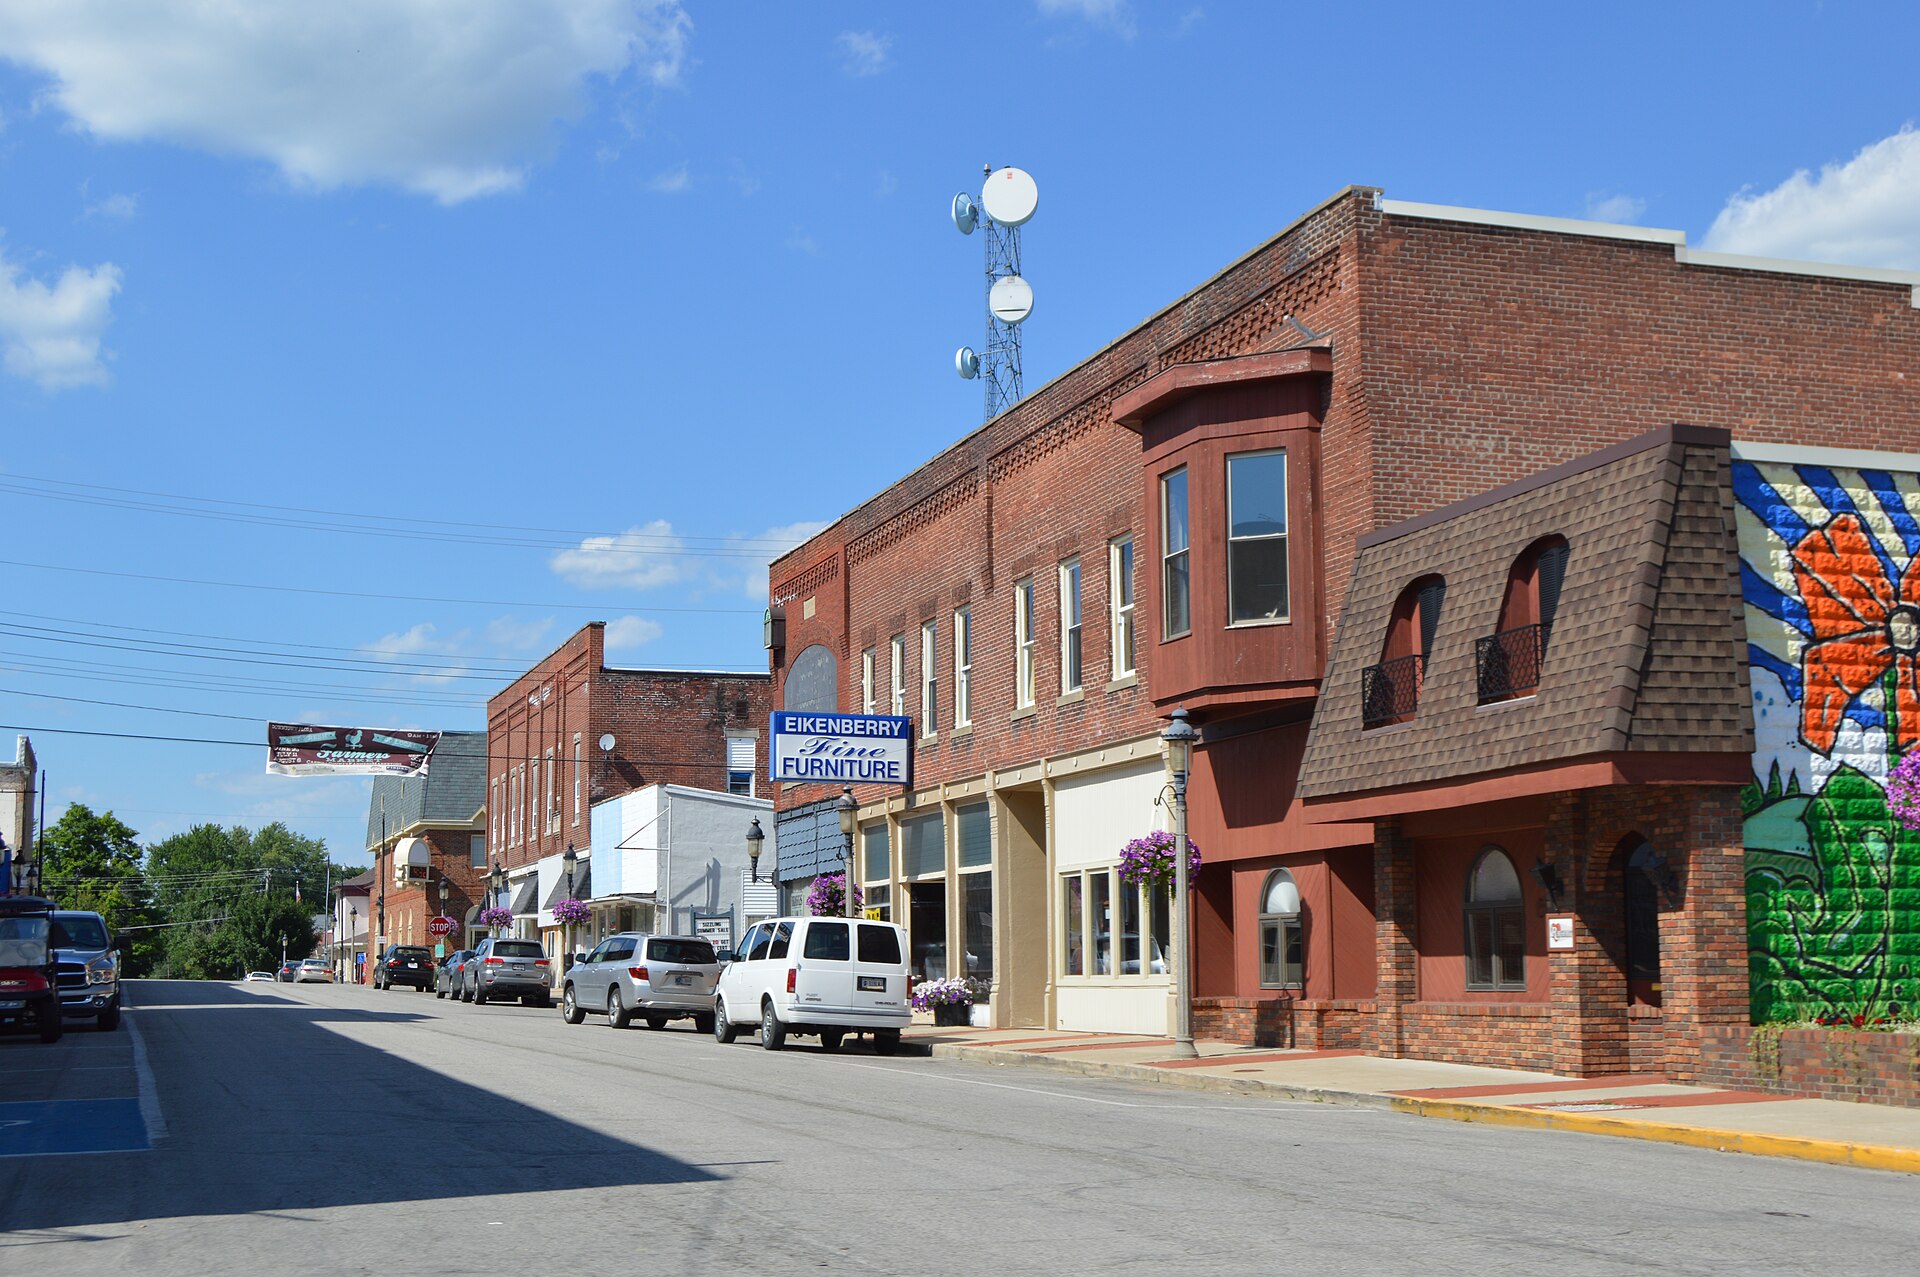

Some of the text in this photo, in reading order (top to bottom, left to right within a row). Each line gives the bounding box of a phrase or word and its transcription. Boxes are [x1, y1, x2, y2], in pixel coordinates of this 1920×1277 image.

[785, 716, 903, 736] EIKENBERRY
[316, 743, 391, 759] Farmers
[798, 735, 886, 757] Fine
[783, 757, 900, 779] FURNITURE
[430, 923, 449, 932] STOP
